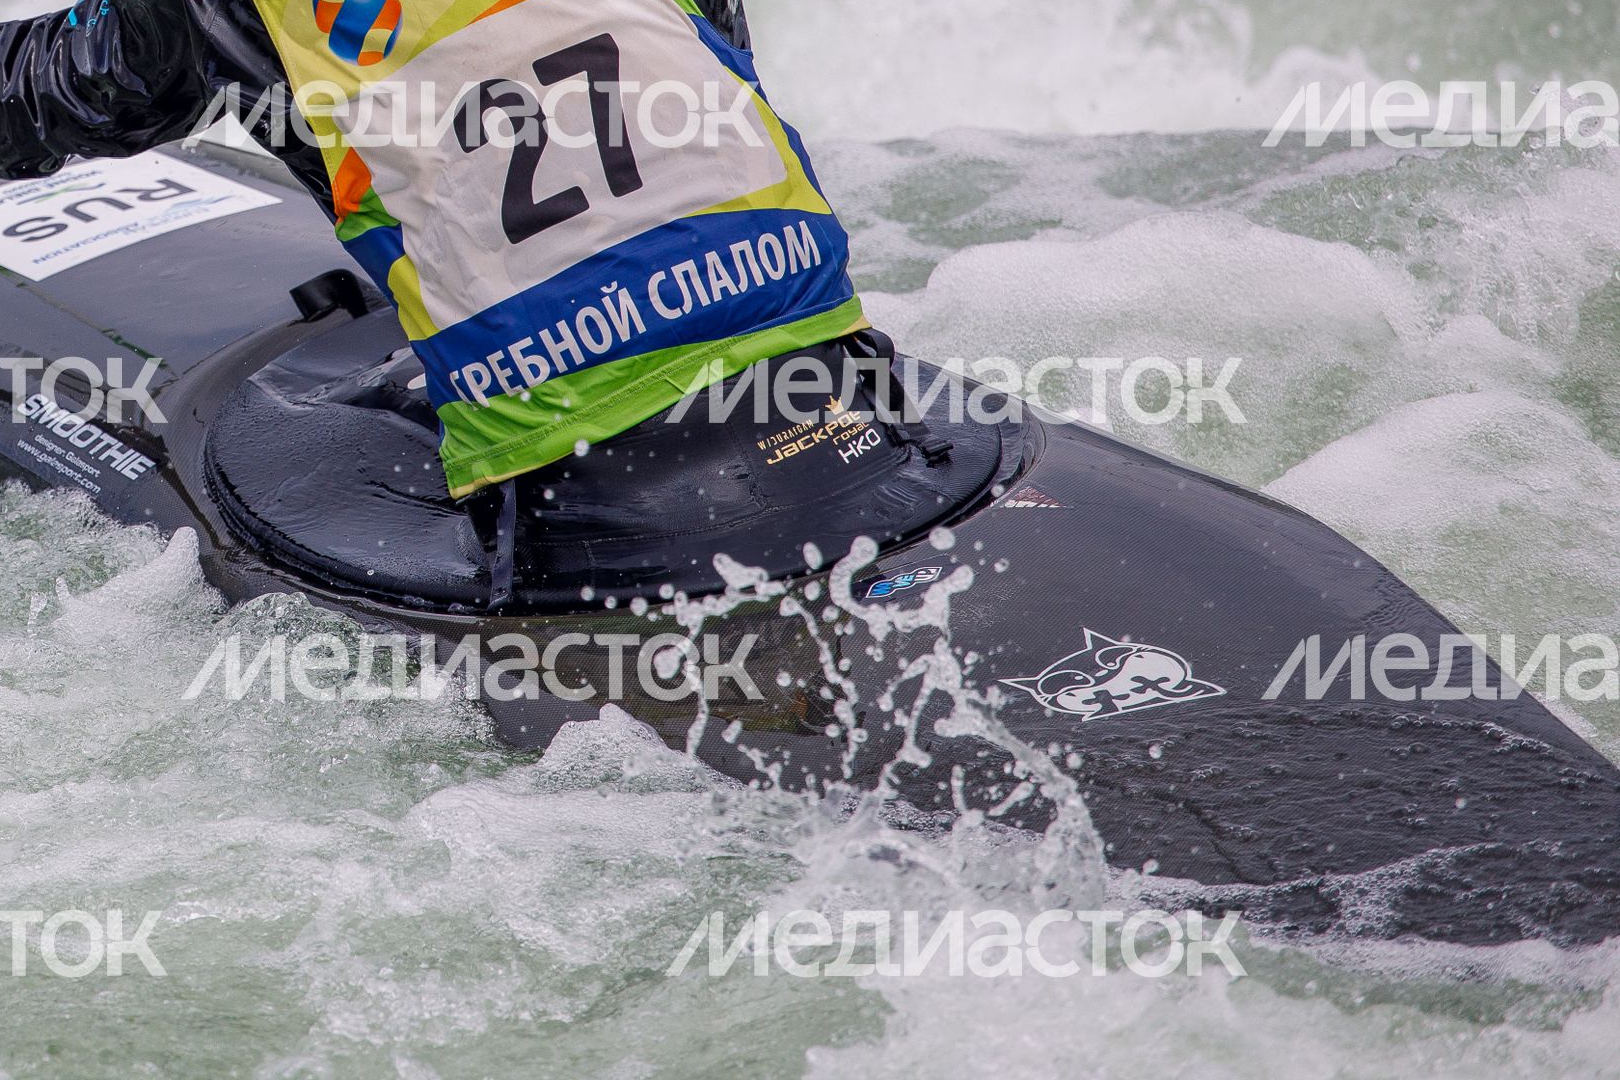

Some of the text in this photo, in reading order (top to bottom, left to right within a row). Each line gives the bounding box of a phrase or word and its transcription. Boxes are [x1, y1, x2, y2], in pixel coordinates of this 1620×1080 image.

[453, 32, 643, 245] 27
[2, 178, 197, 243] RUS
[449, 220, 822, 410] ГРЕБНОЙ СЛАЛОМ
[18, 393, 157, 480] SMOOTHIE
